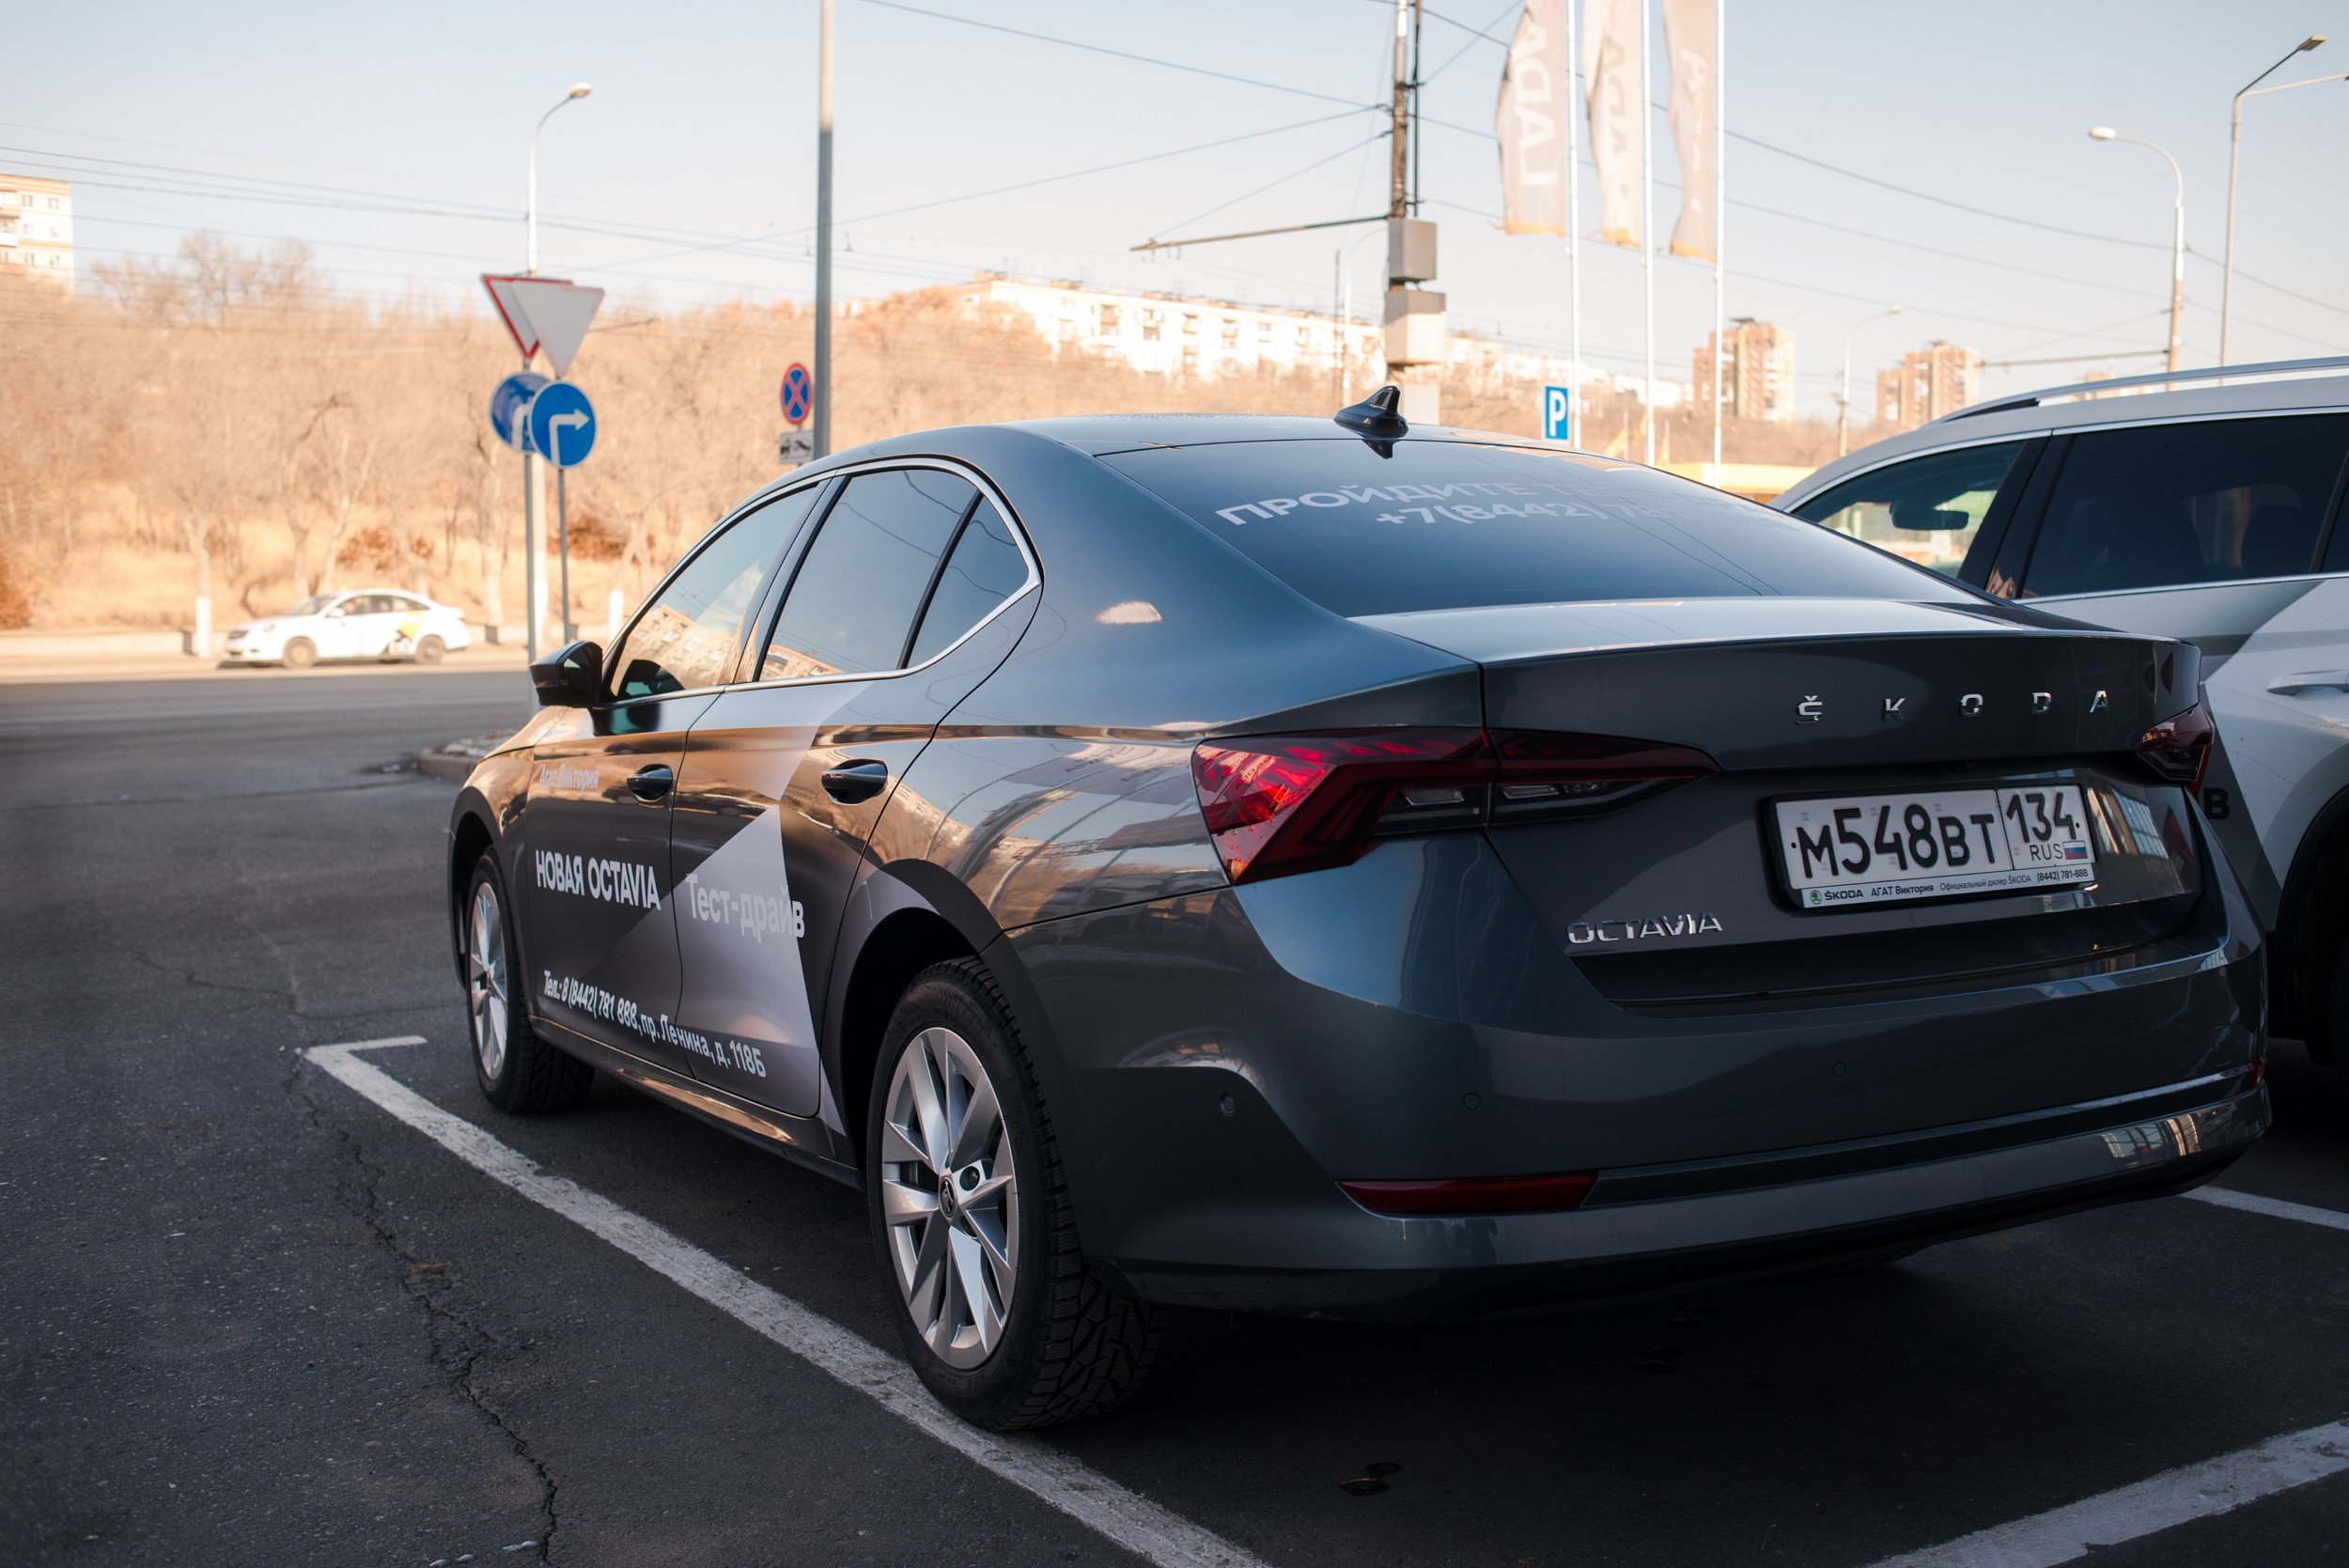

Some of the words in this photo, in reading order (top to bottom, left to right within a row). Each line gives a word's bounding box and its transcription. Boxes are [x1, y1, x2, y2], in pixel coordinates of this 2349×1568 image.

[1548, 389, 1567, 438] P
[1215, 482, 1541, 525] ПРОЙДИТЕ
[2006, 791, 2077, 845] 134
[2030, 842, 2064, 862] RUS
[535, 849, 585, 896] НОВАЯ
[587, 857, 662, 911] OCTAVIA
[1825, 889, 1864, 901] ŠKODA
[1871, 886, 1893, 897] АГАТ
[1895, 883, 1935, 895] Виктория
[1939, 878, 1987, 892] Официальный
[1987, 878, 2008, 888] дилер
[2036, 870, 2060, 882] (8442)
[2061, 867, 2089, 880] 781-888
[686, 873, 805, 943] Тест-драйв
[1566, 910, 1724, 944] OCTAVIA
[568, 977, 598, 1019] (8442)
[599, 989, 615, 1021] 781
[729, 1039, 767, 1079] 118Б
